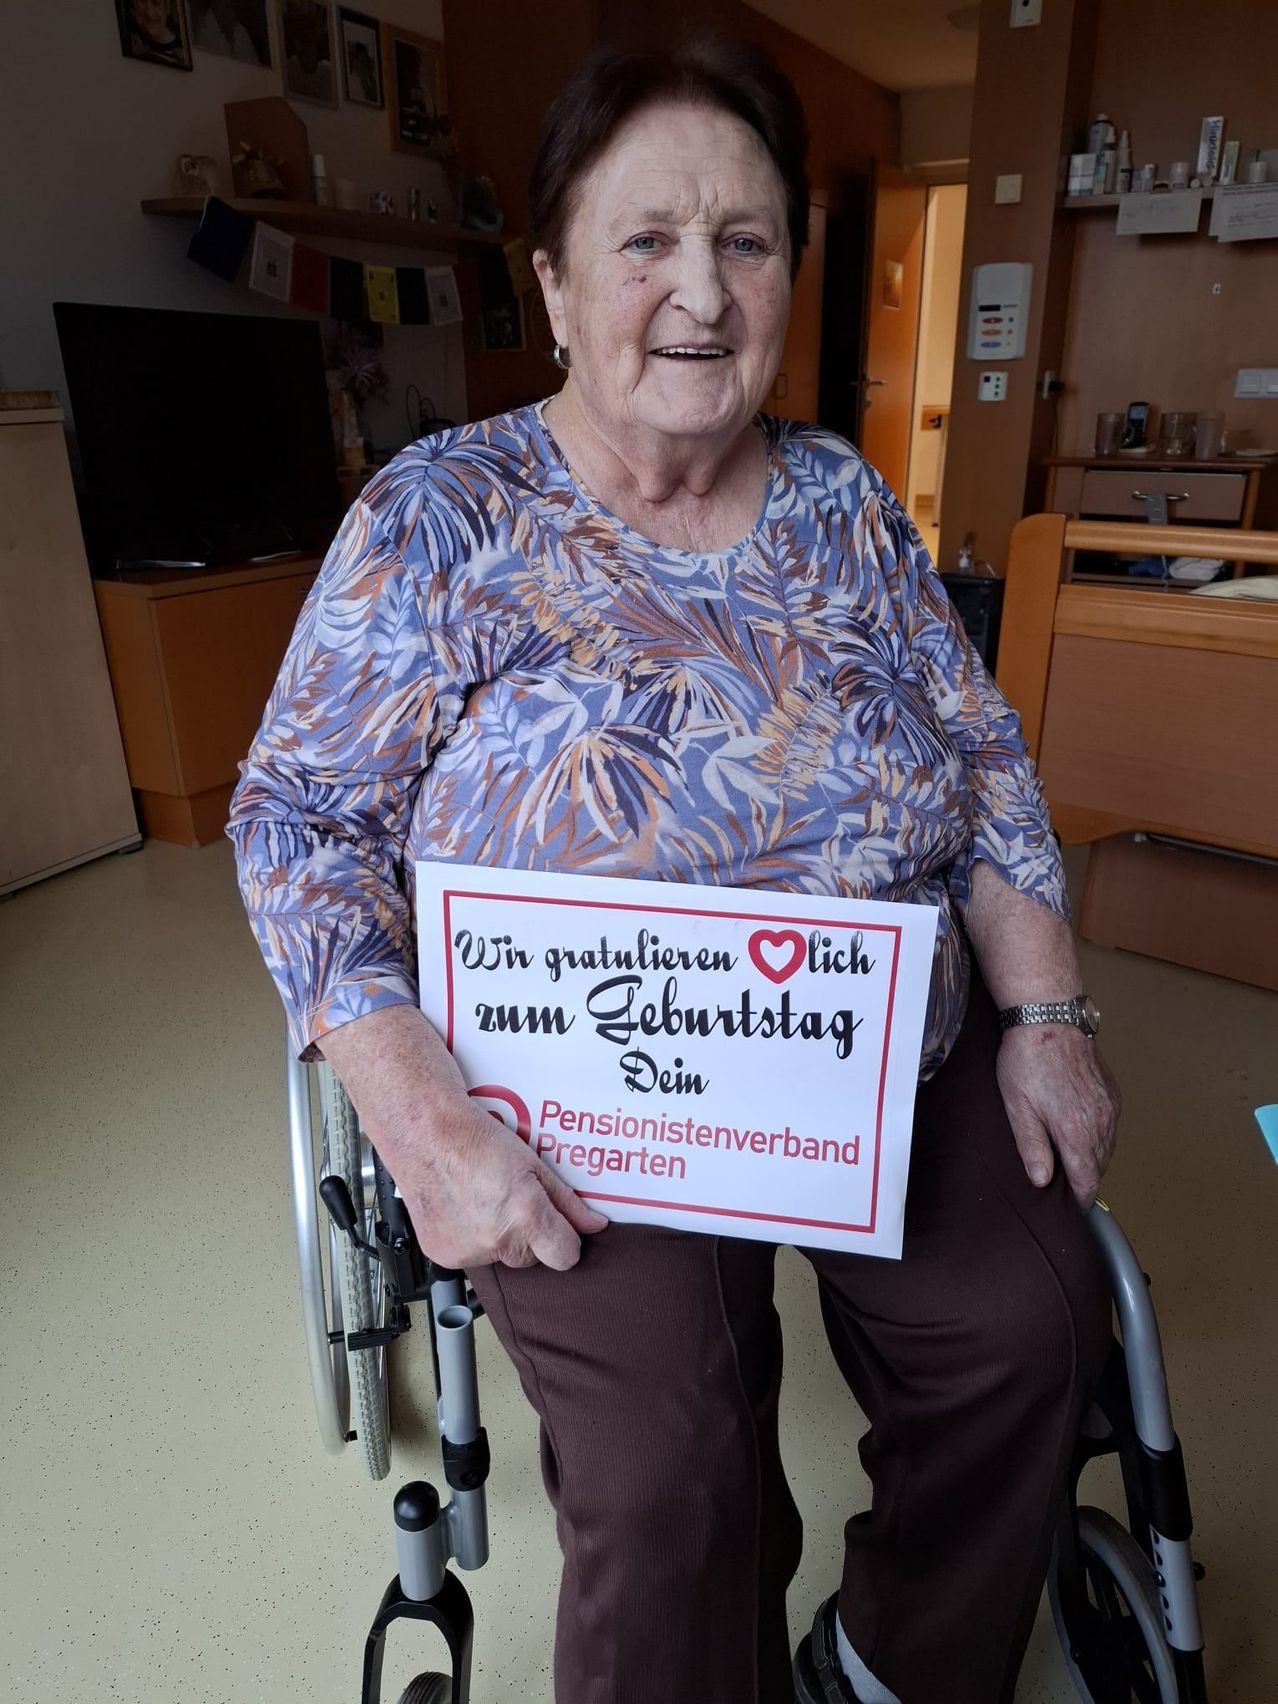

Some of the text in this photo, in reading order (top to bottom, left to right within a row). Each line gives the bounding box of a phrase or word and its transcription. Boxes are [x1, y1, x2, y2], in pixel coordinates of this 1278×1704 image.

[454, 928, 876, 983] Wir gratulieren lich
[475, 974, 864, 1060] zum Geburtstag
[619, 1046, 710, 1096] Dein
[535, 1132, 687, 1180] Pregarten
[539, 1099, 861, 1166] Pensionistenverband
